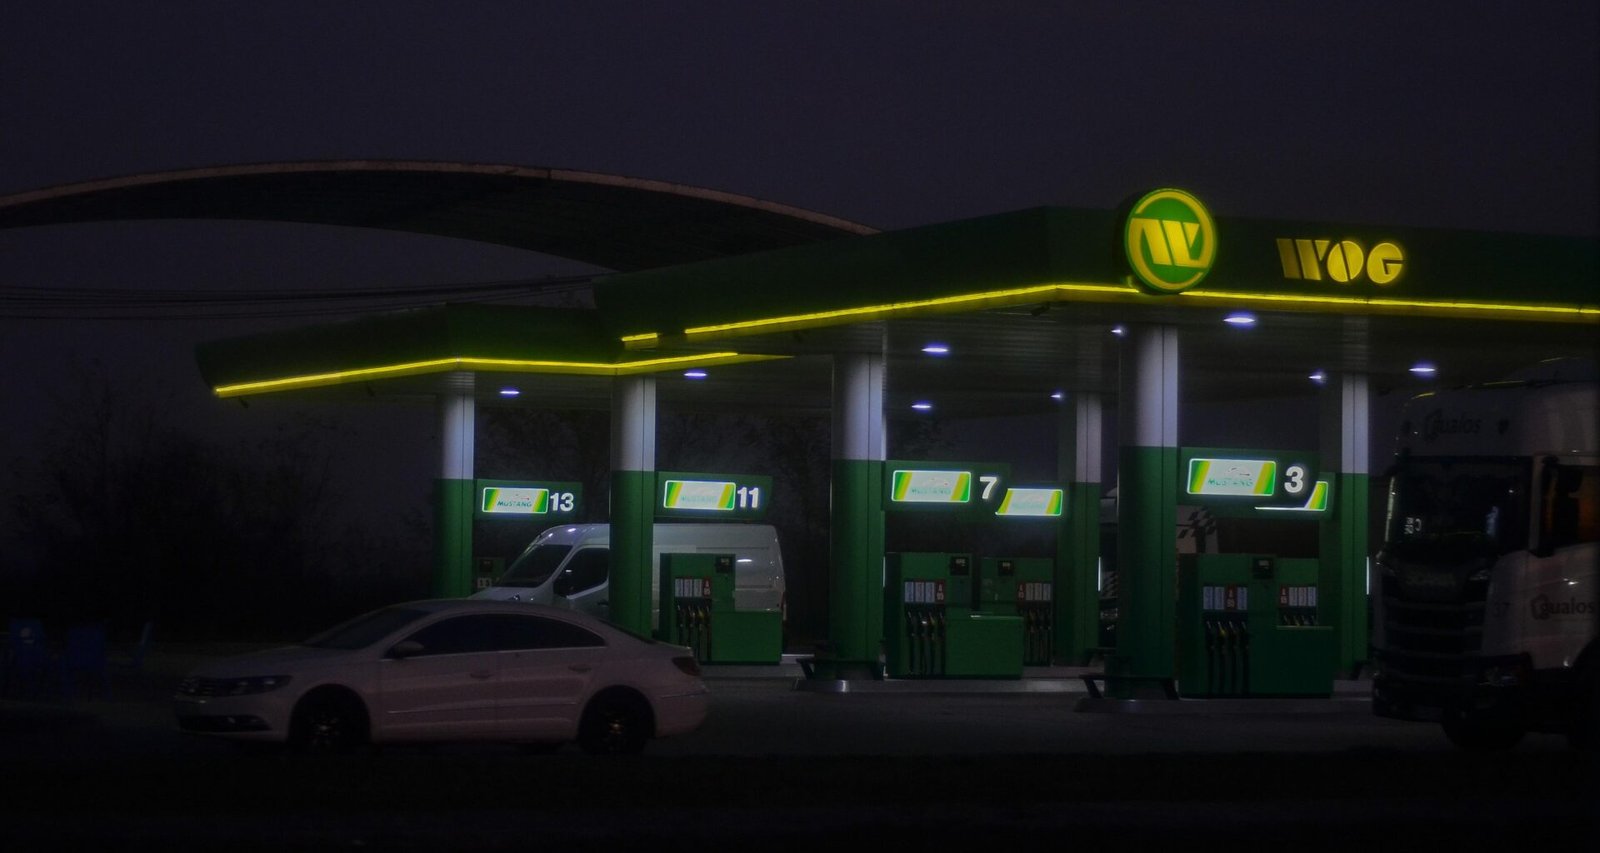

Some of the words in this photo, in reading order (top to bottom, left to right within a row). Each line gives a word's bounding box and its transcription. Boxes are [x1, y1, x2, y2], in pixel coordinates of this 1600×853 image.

[1276, 238, 1404, 284] WOG
[979, 476, 998, 499] 7
[1284, 466, 1304, 493] 3
[550, 492, 575, 512] 13
[737, 487, 759, 508] 11
